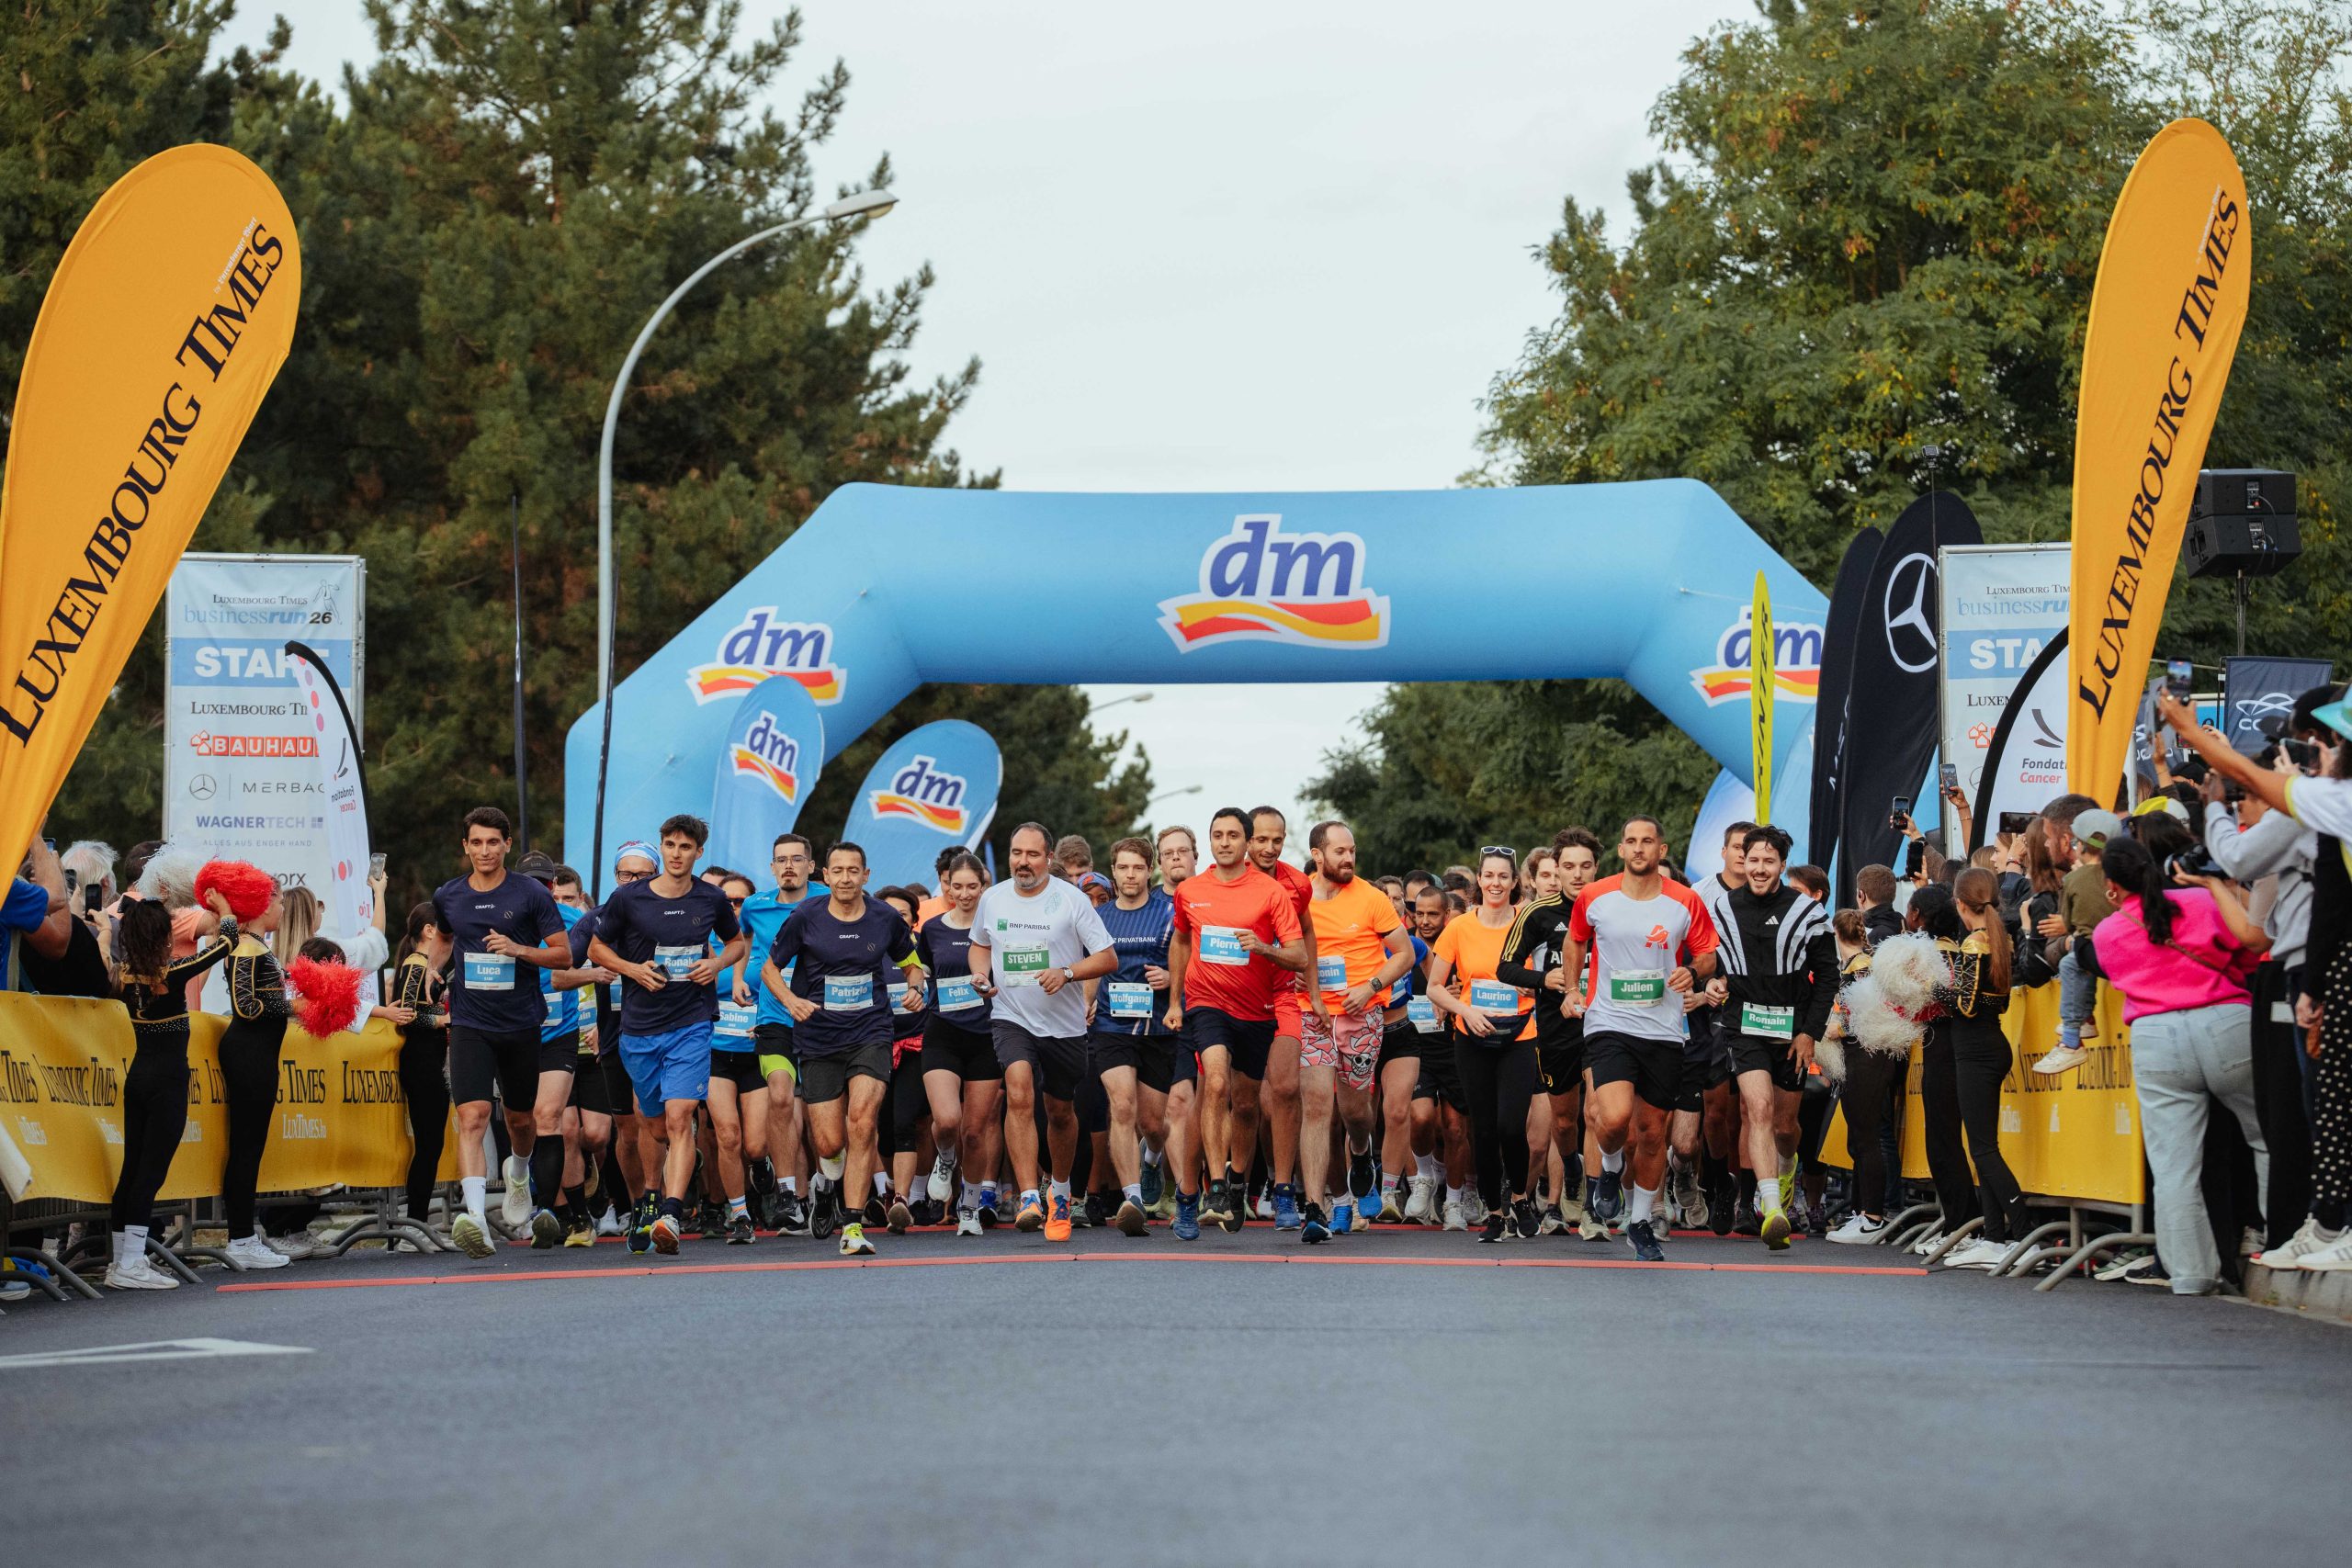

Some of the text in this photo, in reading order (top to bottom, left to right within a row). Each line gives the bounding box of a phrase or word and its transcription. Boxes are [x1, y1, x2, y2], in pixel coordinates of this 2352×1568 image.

[2079, 355, 2194, 726] LUXEMBOURG
[2175, 189, 2239, 353] TIMES
[0, 223, 285, 749] LUXEMBOURG TIMES
[1209, 521, 1355, 598] dm
[1986, 584, 2070, 595] LUXEMBOURG TIM
[212, 593, 308, 605] LUXEMBOURG TIMES
[1958, 597, 2069, 616] businessru
[309, 611, 334, 625] 26
[724, 613, 826, 668] dm
[1969, 637, 2044, 670] STA
[190, 701, 287, 716] LUXEMBOURG
[213, 738, 313, 756] BAUHAU
[748, 716, 797, 772] dm
[2021, 758, 2067, 771] Fondat
[895, 760, 964, 807] dm
[2019, 772, 2062, 784] Cancer
[196, 816, 305, 829] WAGNERTECH
[202, 839, 232, 847] ALLES
[1210, 937, 1240, 950] Pierre
[1007, 952, 1043, 964] STEVEN
[477, 964, 502, 976] Luca
[831, 986, 868, 997] Patrizio
[948, 987, 970, 998] Felix
[1620, 981, 1654, 993] Julien
[1110, 993, 1151, 1006] Wolfgang
[1476, 989, 1512, 1001] Laurine
[719, 1010, 749, 1023] Sabine
[1748, 1012, 1786, 1026] Romain
[283, 1059, 401, 1104] TIMES LUXEMBO
